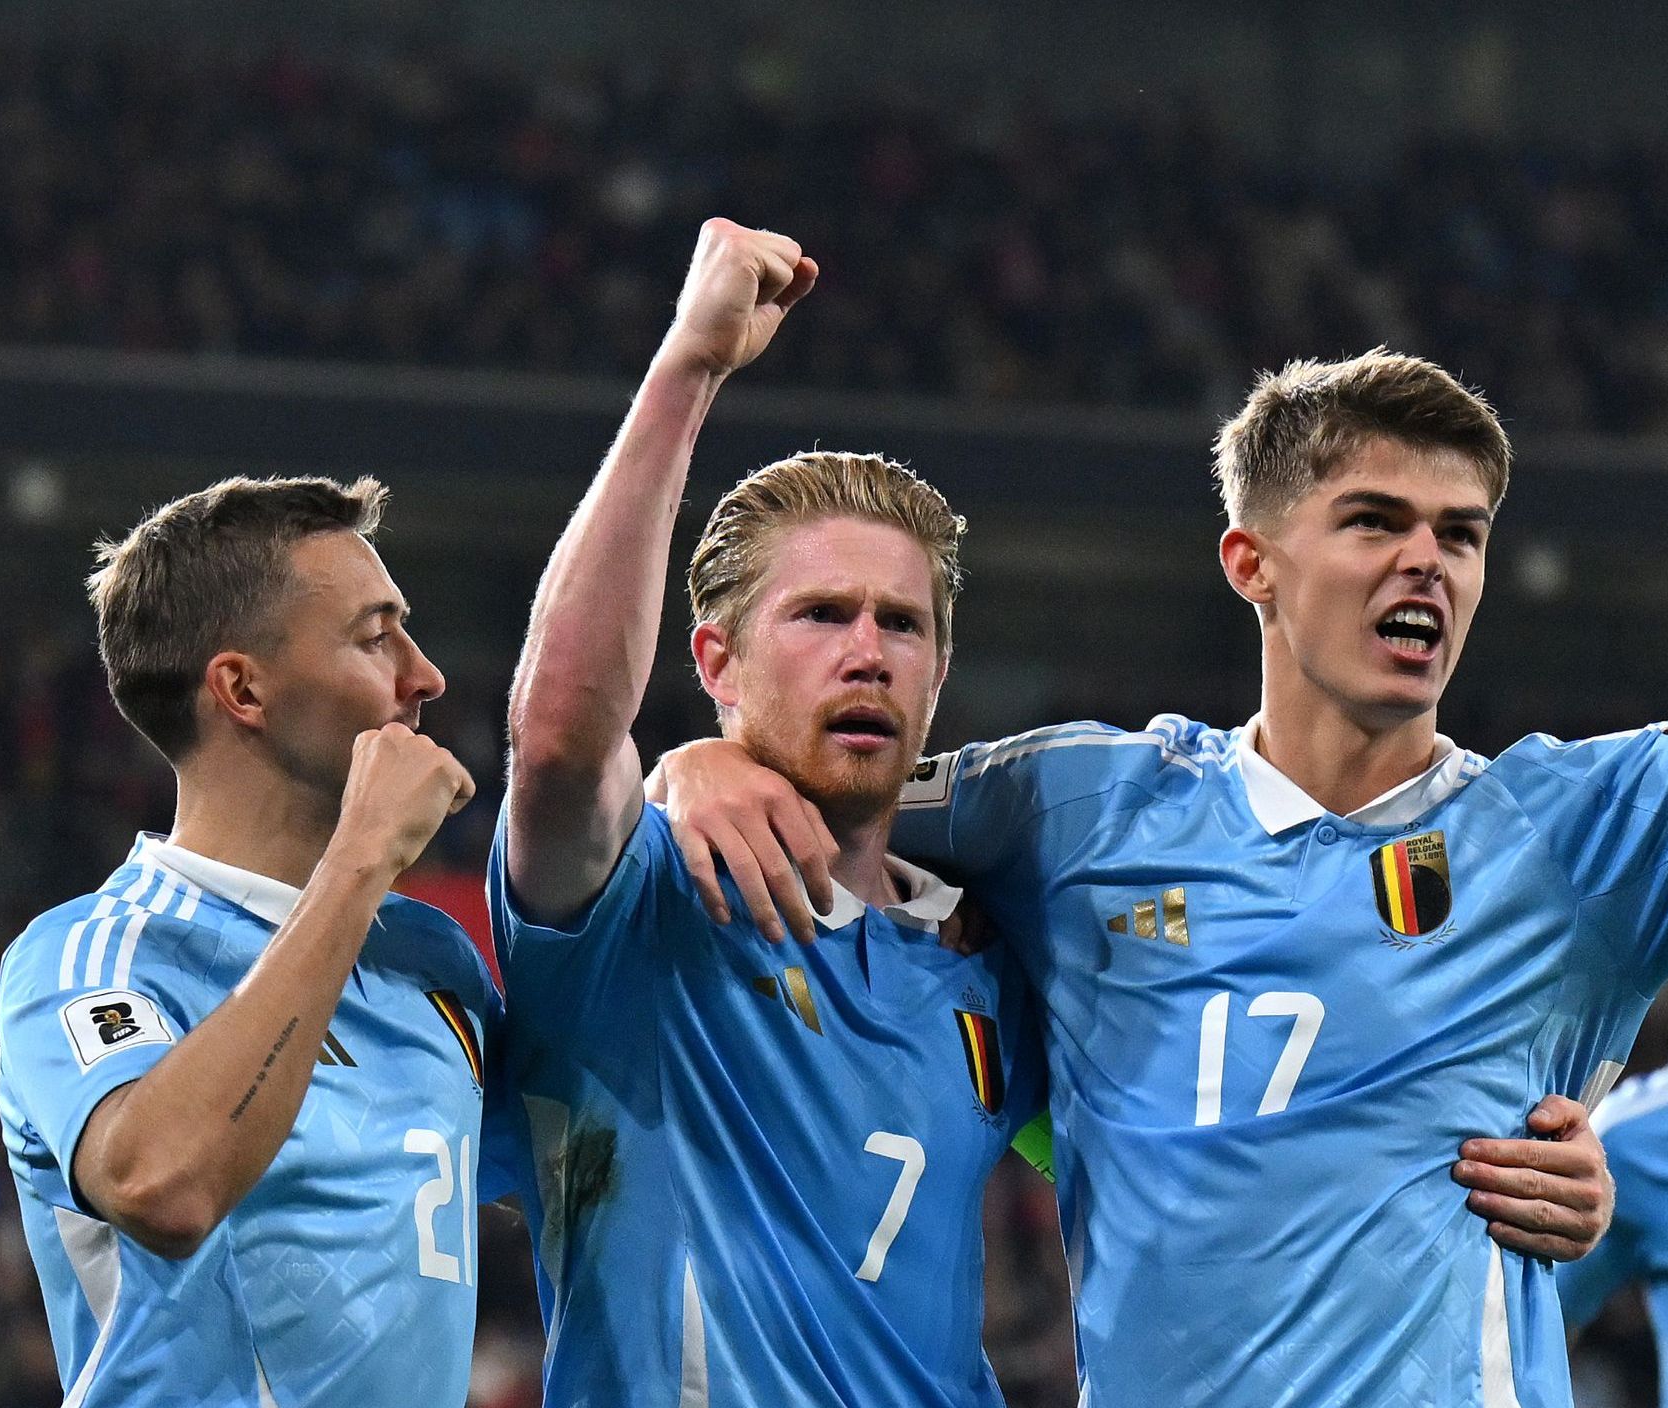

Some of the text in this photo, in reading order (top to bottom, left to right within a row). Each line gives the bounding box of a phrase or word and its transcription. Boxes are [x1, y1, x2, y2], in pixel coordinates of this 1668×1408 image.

[1406, 836, 1433, 846] ROYAL
[1407, 842, 1444, 854] BELGIAN
[112, 1027, 133, 1040] FIFA
[1194, 991, 1325, 1127] 17
[403, 1128, 473, 1287] 21
[855, 1131, 926, 1283] 7
